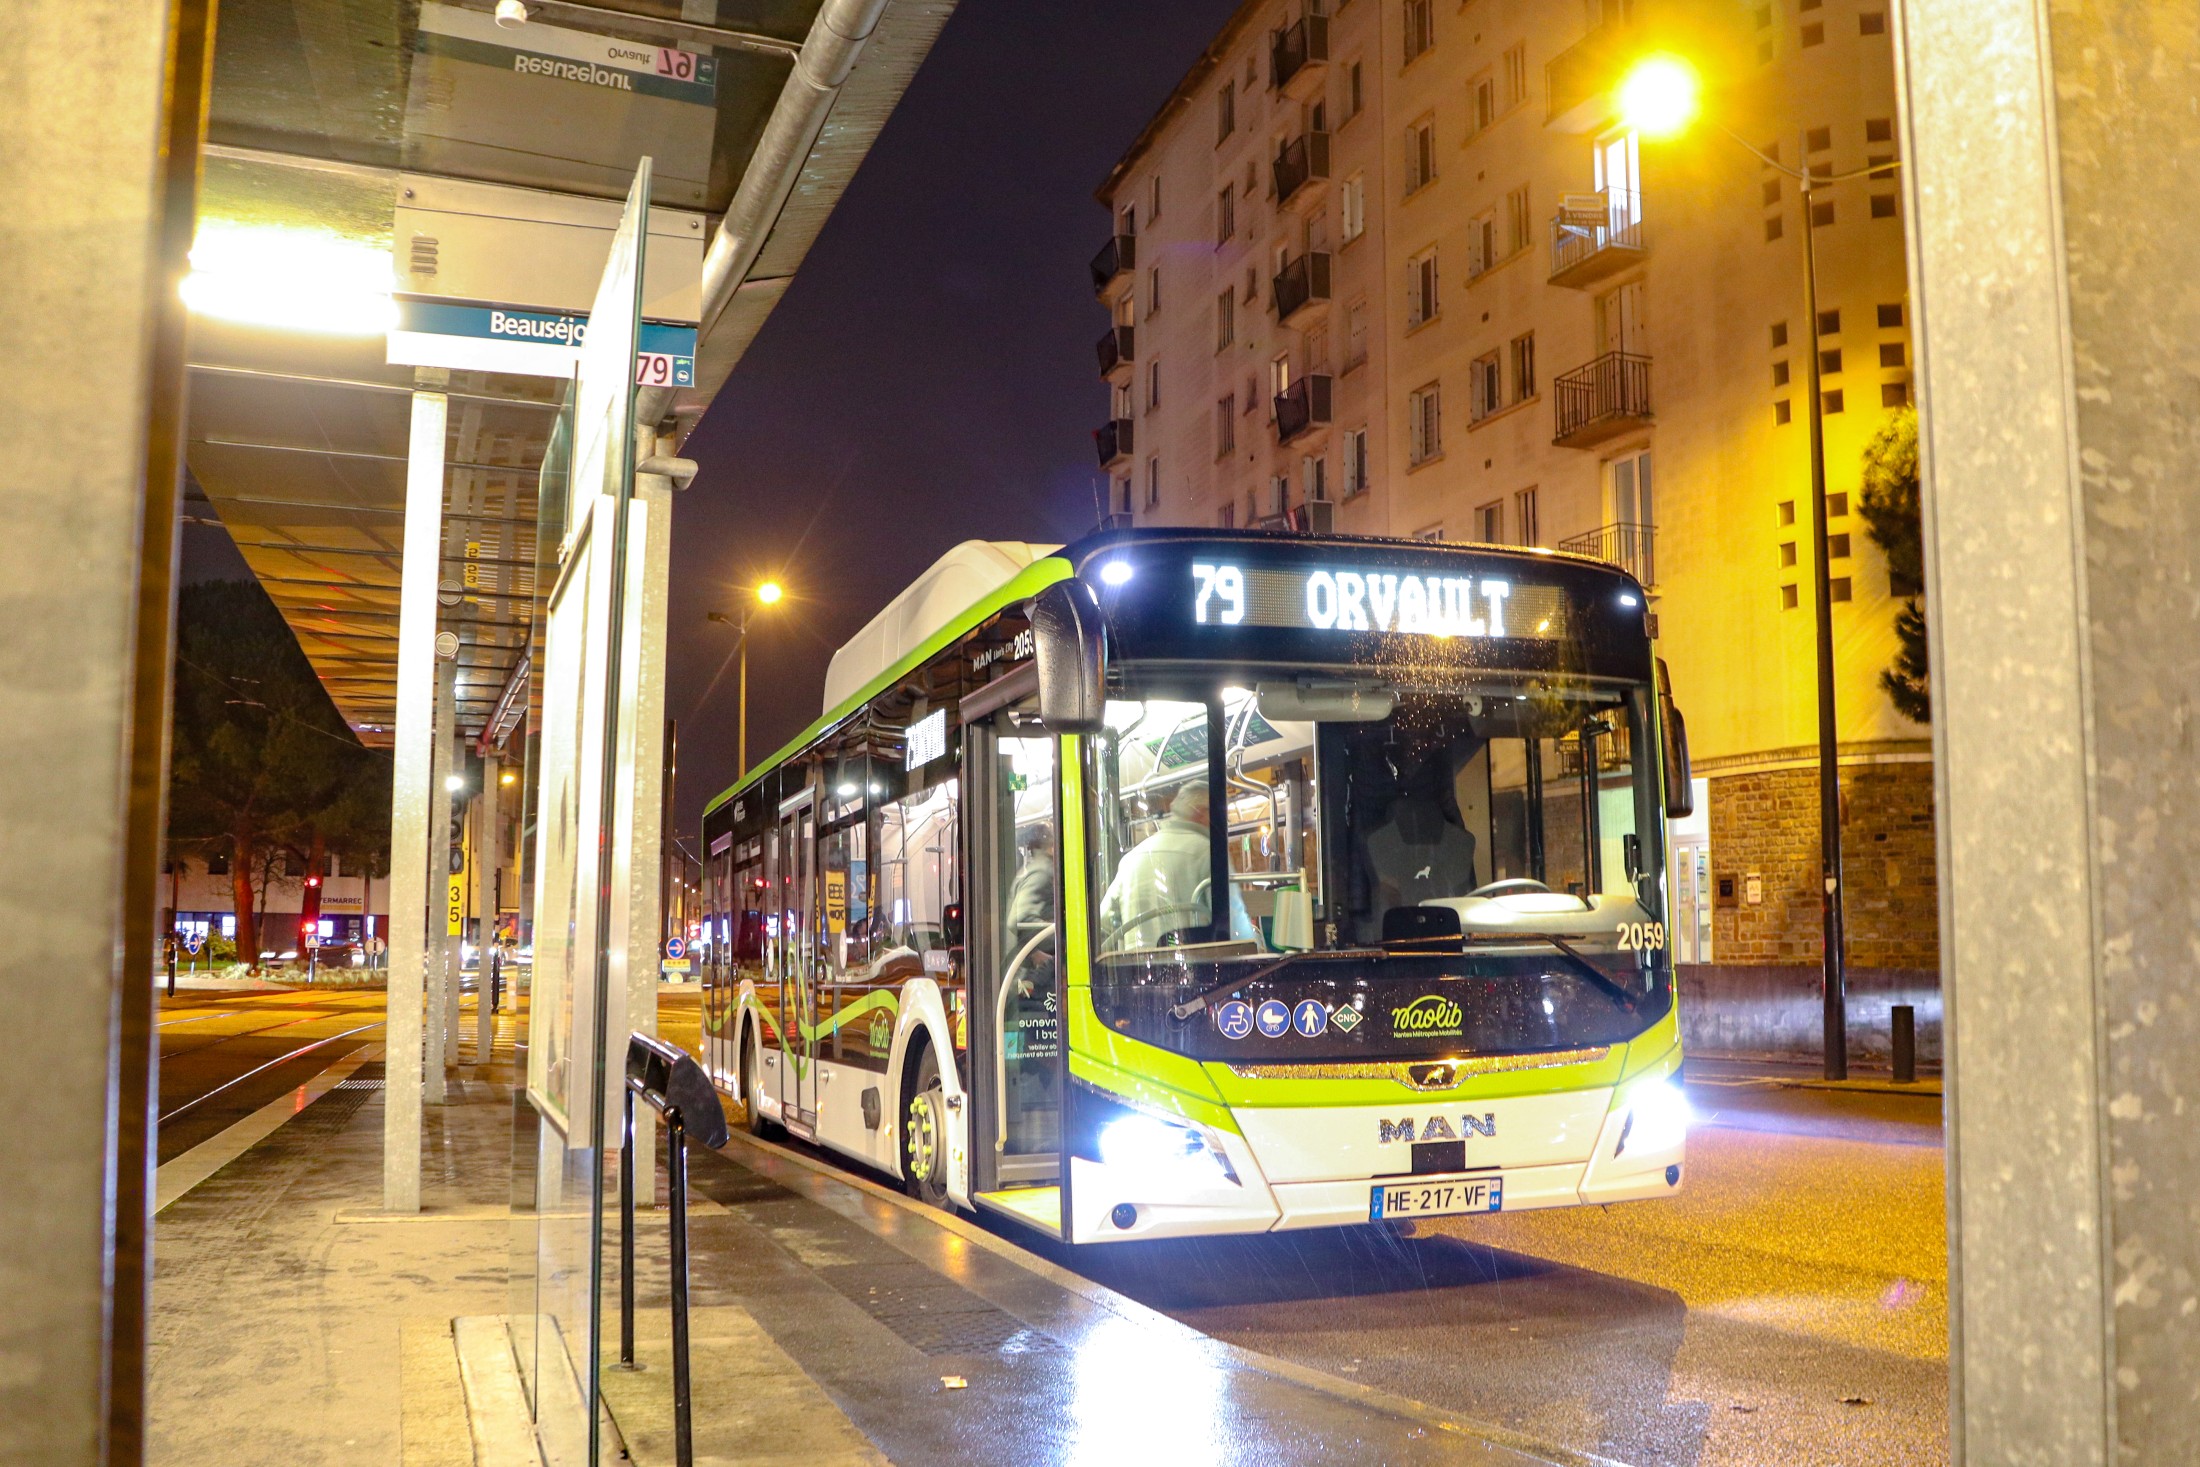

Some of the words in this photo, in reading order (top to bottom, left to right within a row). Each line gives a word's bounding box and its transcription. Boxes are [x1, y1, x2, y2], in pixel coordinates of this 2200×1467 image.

[637, 355, 669, 384] 79
[1193, 564, 1244, 625] 79
[1307, 570, 1509, 638] ORVAULT
[973, 648, 992, 673] MAN
[1616, 922, 1664, 951] 2059
[1337, 1013, 1357, 1023] CNG
[1393, 1031, 1412, 1039] Nantes
[1413, 1030, 1438, 1039] Métropole
[1438, 1029, 1463, 1037] Mobilités
[1378, 1112, 1497, 1144] MAN
[1387, 1186, 1485, 1212] HE-217-VF
[1490, 1195, 1500, 1206] 44
